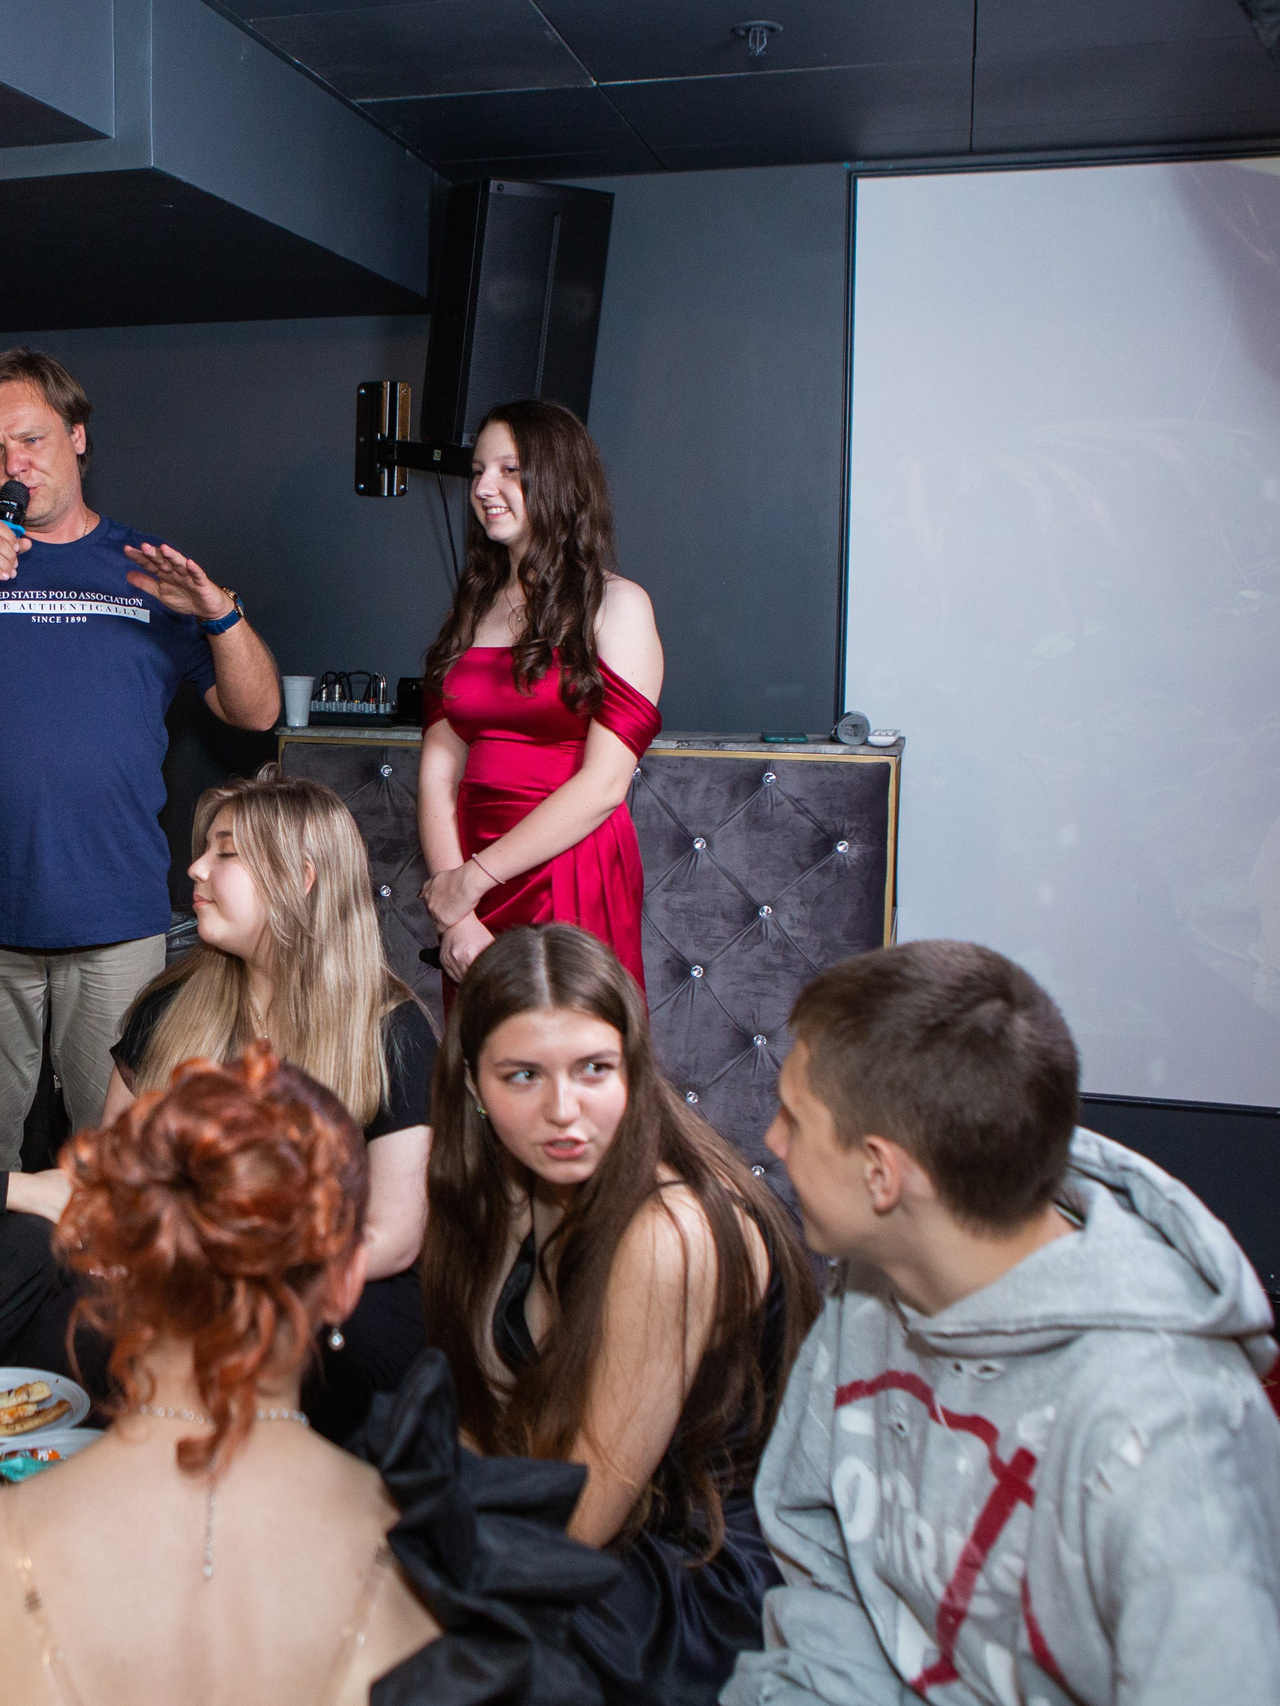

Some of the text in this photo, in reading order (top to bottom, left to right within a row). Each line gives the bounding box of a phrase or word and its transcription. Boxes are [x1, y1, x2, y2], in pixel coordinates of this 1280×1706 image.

[11, 590, 47, 599] STATES
[48, 590, 77, 599] POLO
[78, 591, 143, 607] ASSOCIATION
[19, 603, 138, 616] AUTHENTICALLY
[31, 615, 62, 624] SINCE
